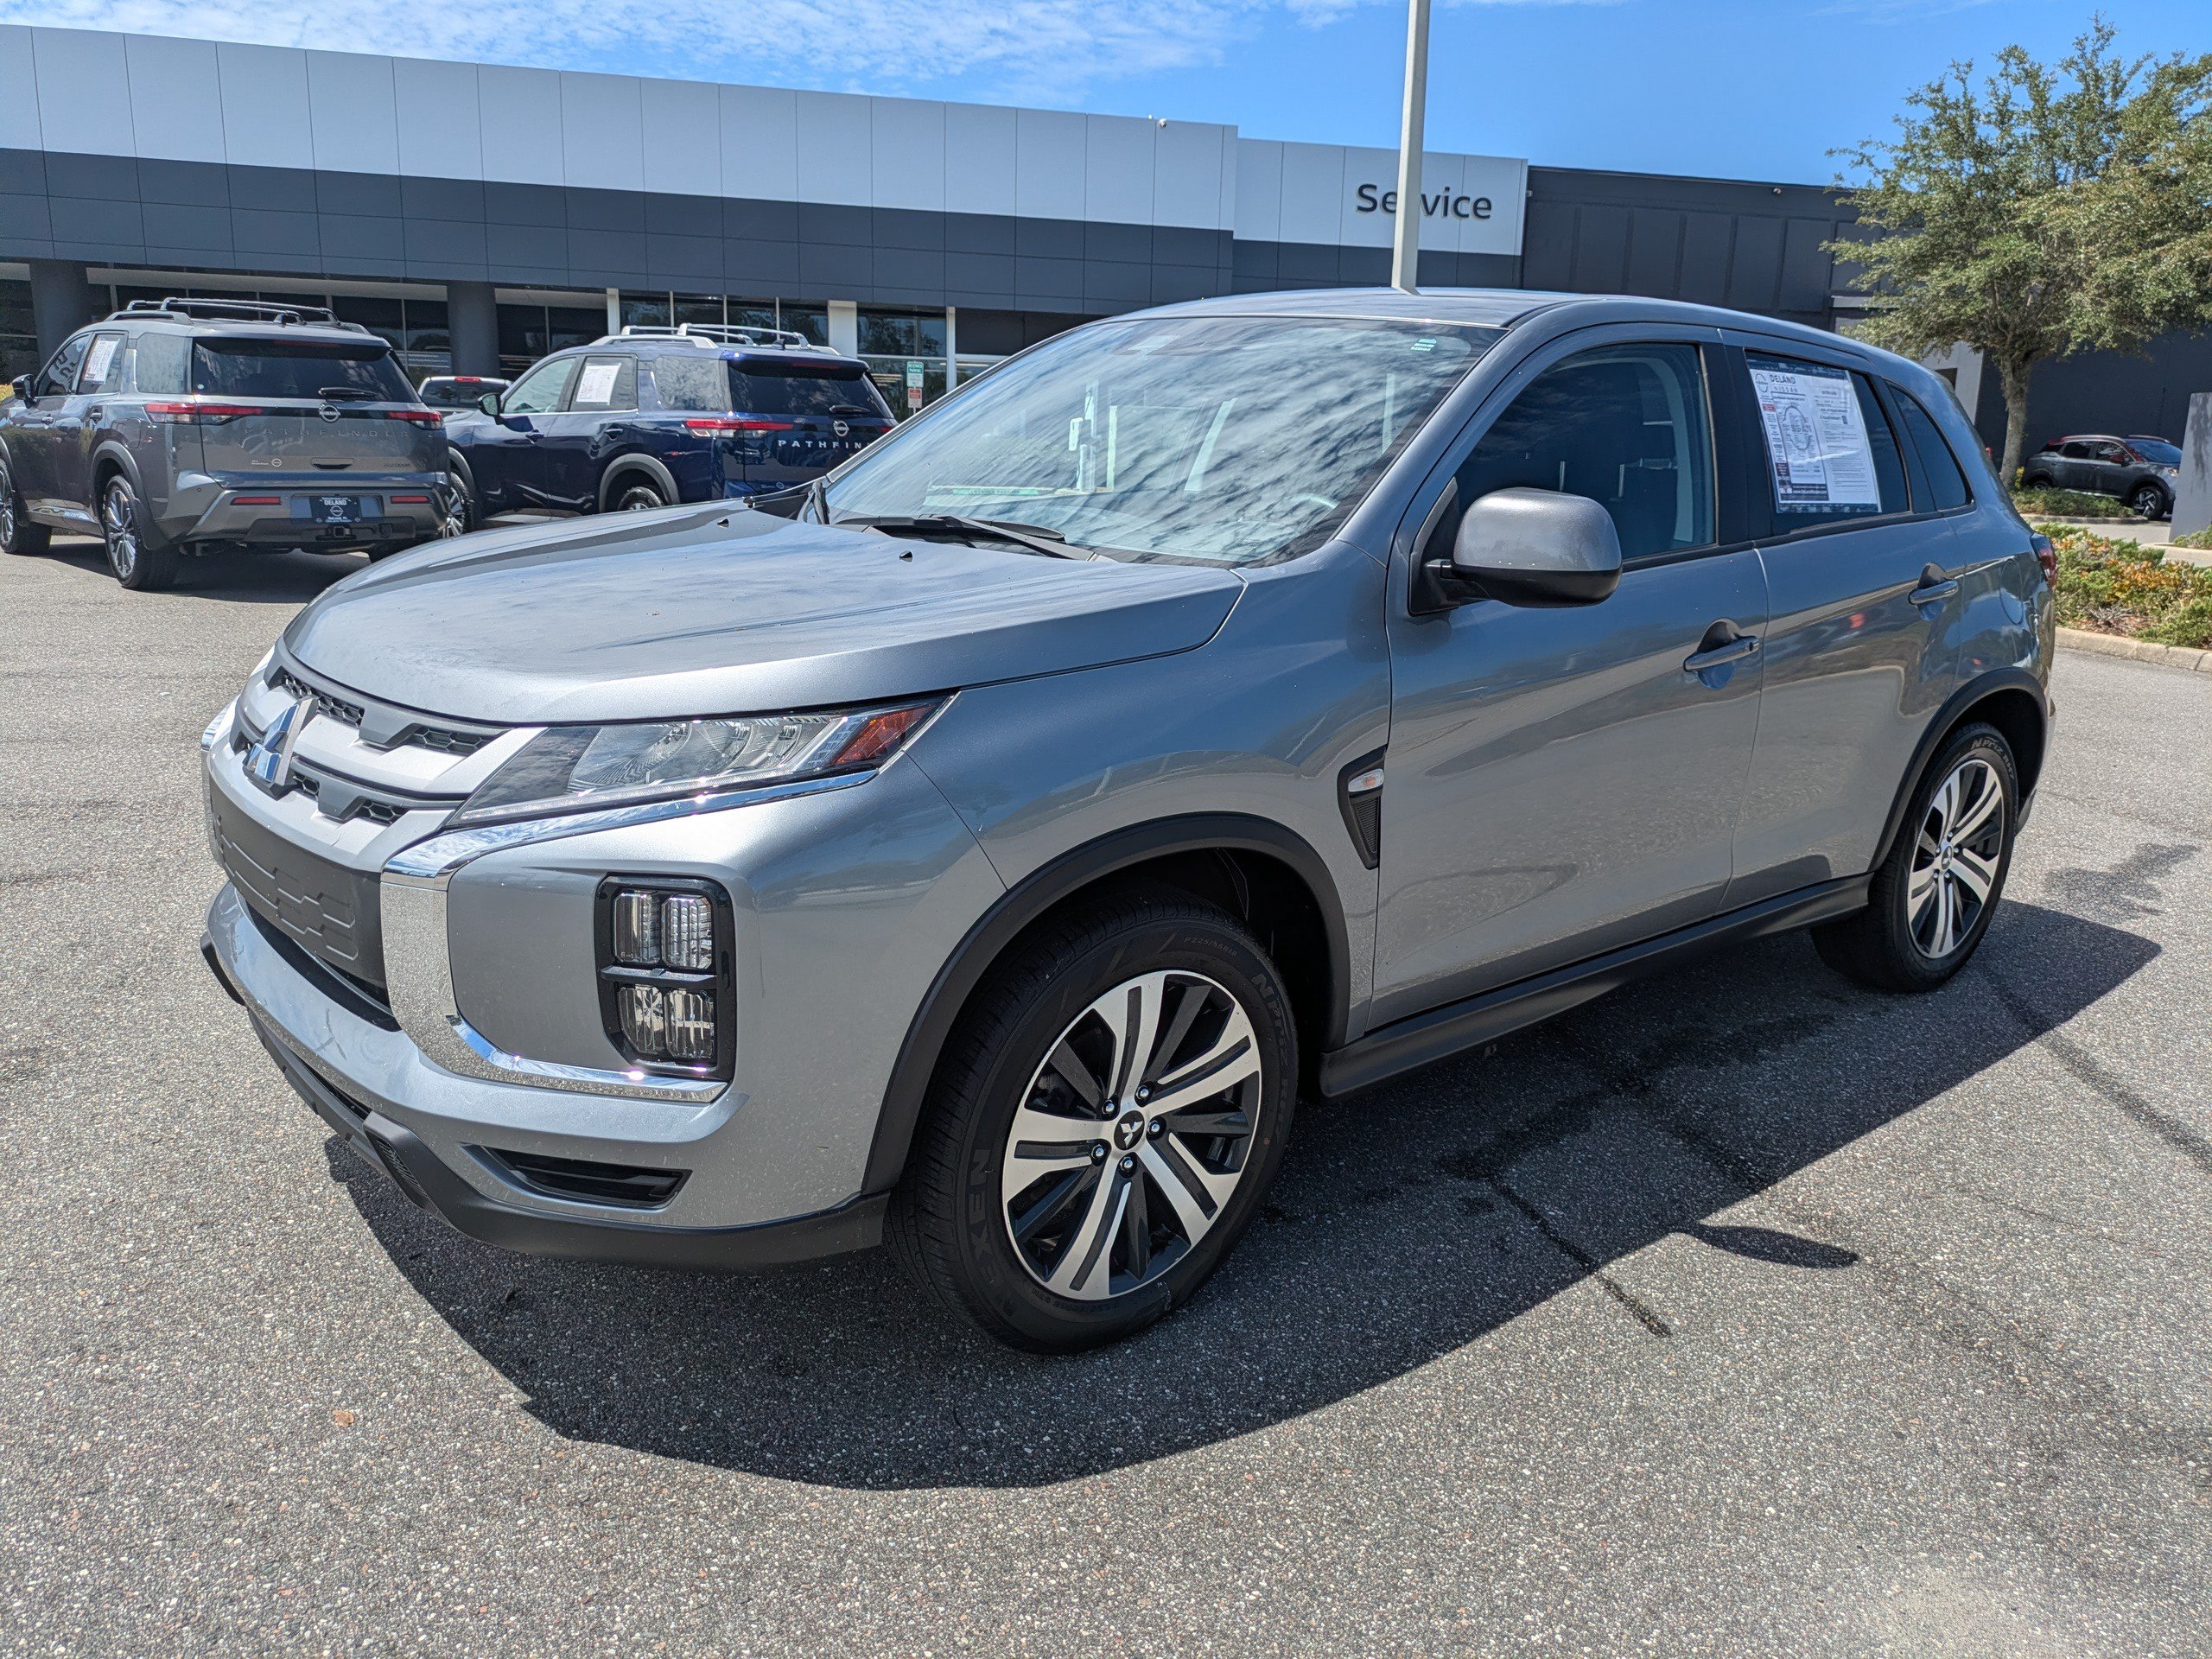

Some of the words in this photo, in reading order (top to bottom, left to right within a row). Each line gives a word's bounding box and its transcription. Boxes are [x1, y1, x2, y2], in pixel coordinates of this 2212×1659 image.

[1357, 183, 1492, 219] Sevice
[1769, 374, 1796, 385] DELAND
[778, 439, 870, 449] PATHFIN
